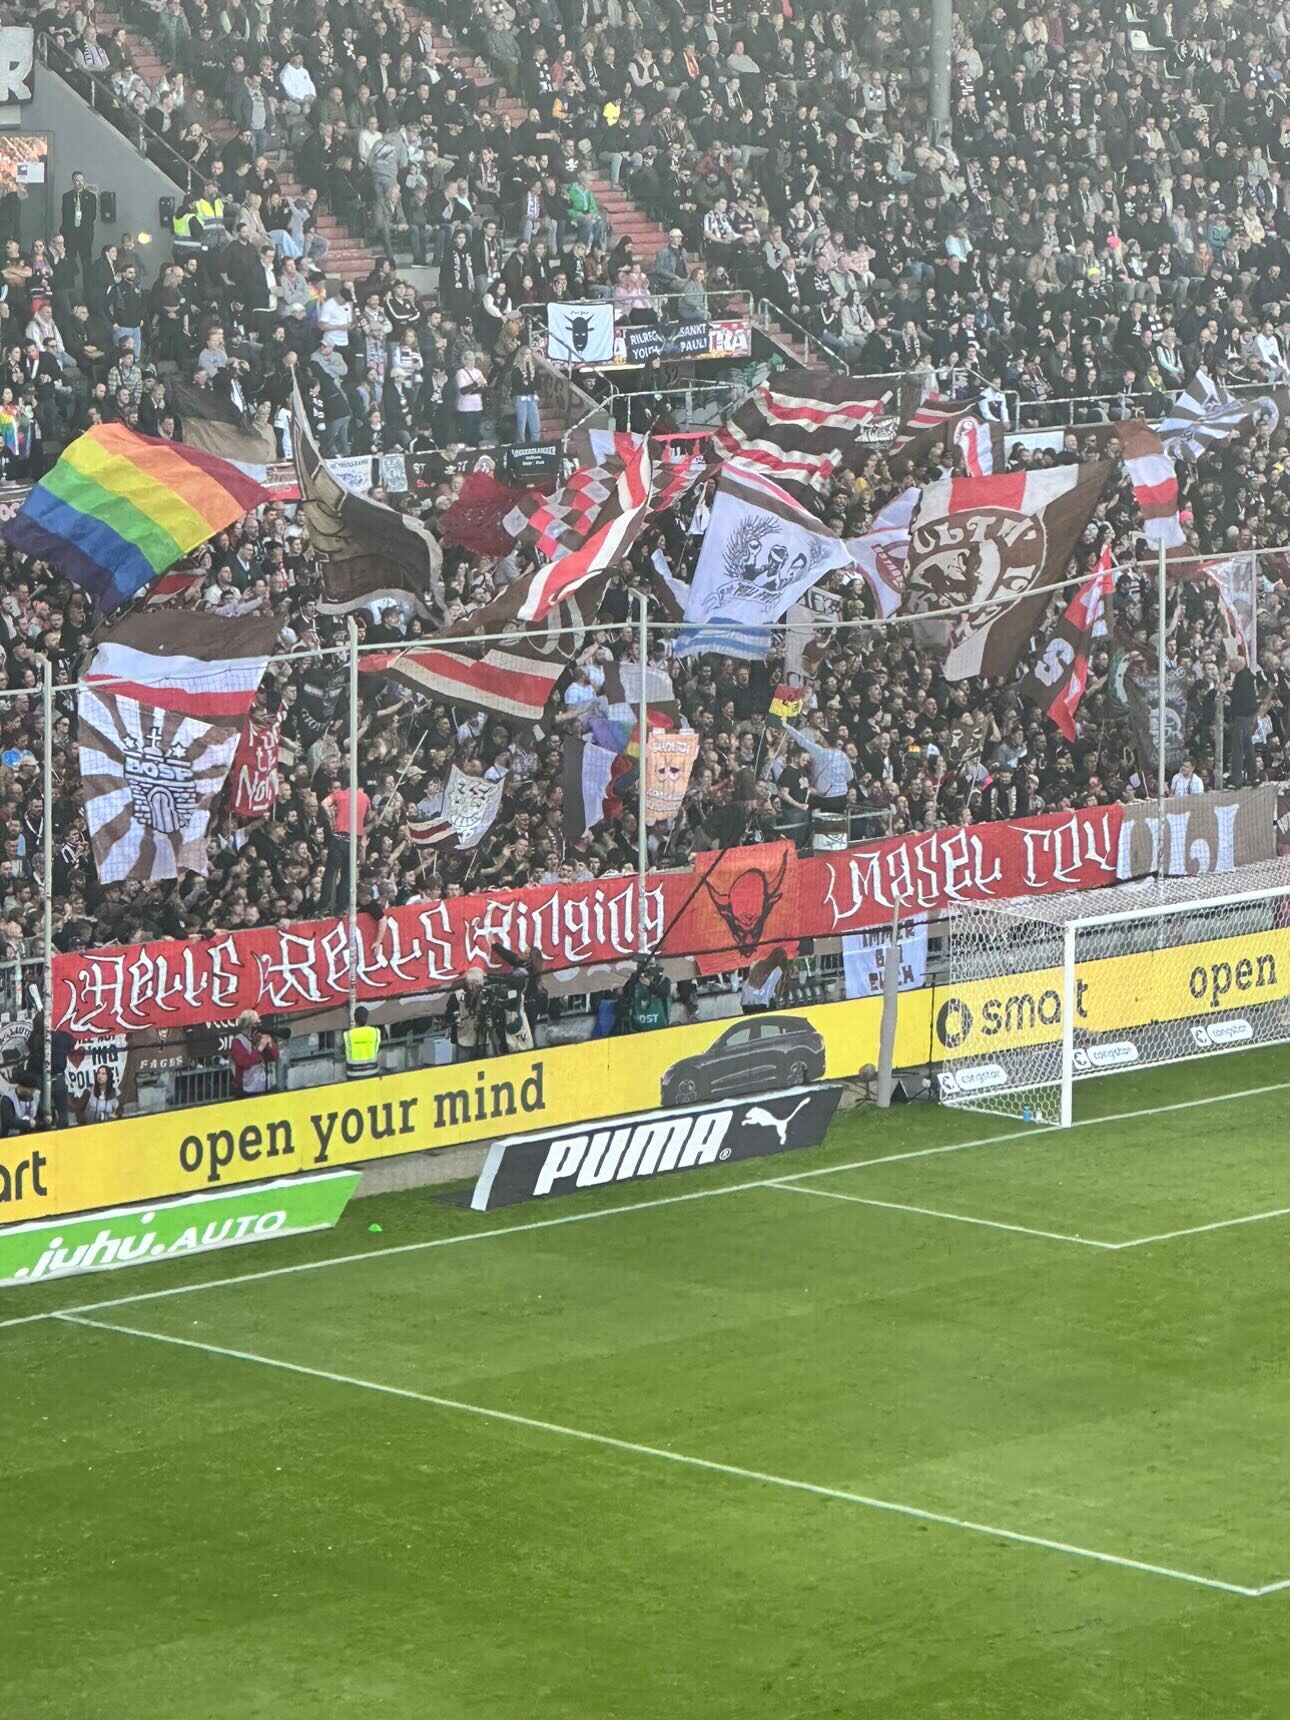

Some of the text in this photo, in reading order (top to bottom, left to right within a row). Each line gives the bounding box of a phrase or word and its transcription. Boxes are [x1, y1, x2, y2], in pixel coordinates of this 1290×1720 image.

[680, 323, 707, 337] SANKT
[680, 338, 707, 352] PAULI
[875, 945, 903, 968] BI
[980, 953, 1278, 1036] smat open
[1212, 1023, 1249, 1039] congstar
[1093, 1045, 1133, 1061] congstar
[961, 1069, 1001, 1084] congstar
[179, 1062, 545, 1182] open your mind
